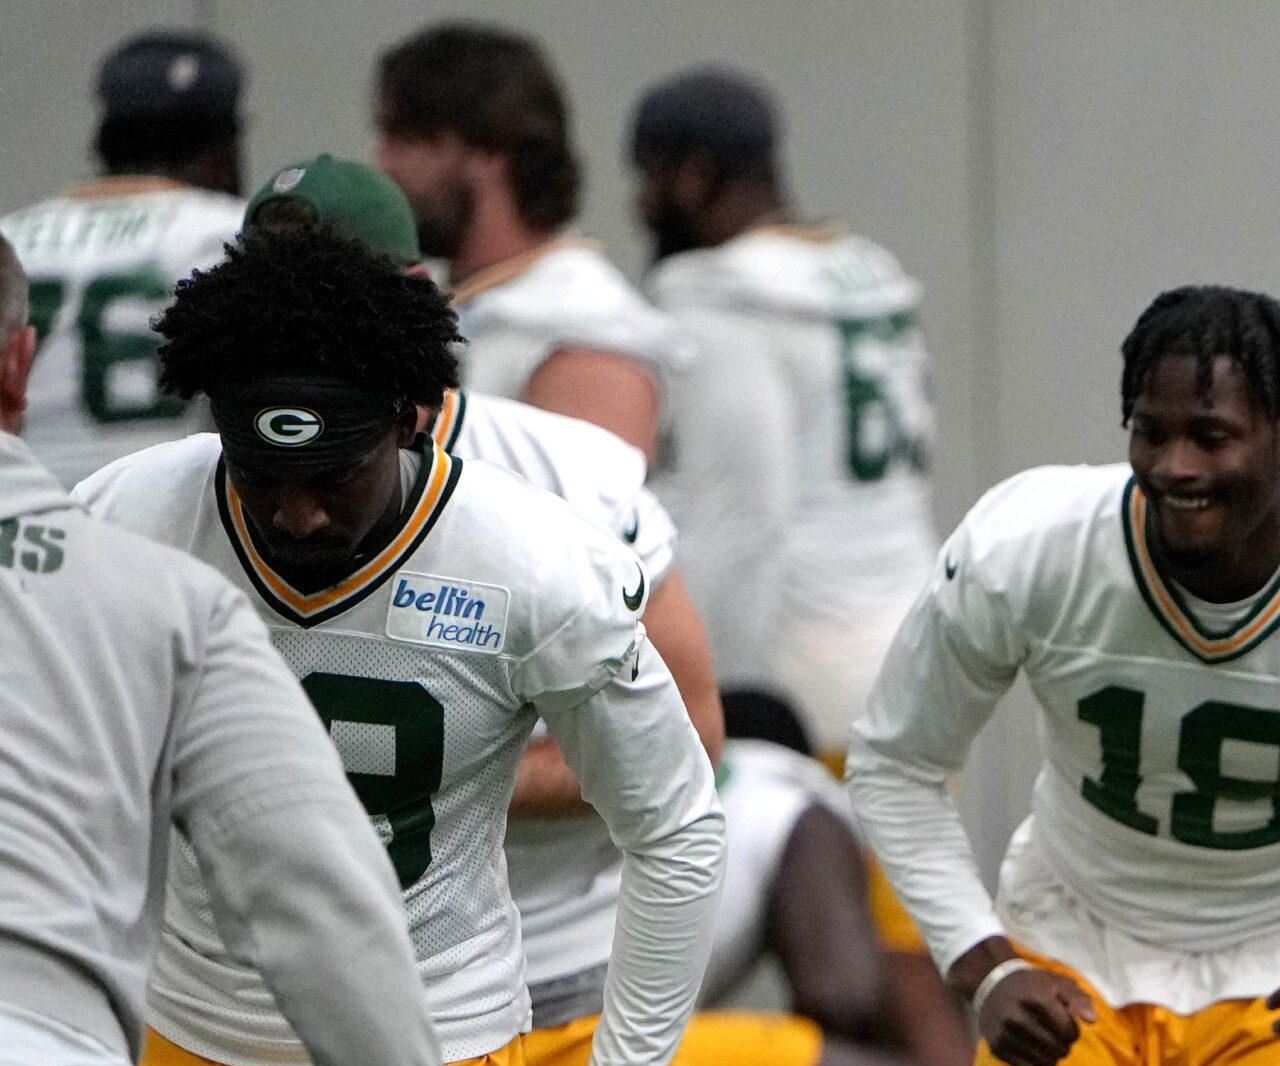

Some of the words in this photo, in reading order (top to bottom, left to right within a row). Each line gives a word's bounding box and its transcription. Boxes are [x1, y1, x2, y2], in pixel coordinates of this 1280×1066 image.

[256, 408, 321, 445] G
[392, 578, 486, 621] bellin
[426, 615, 501, 648] health
